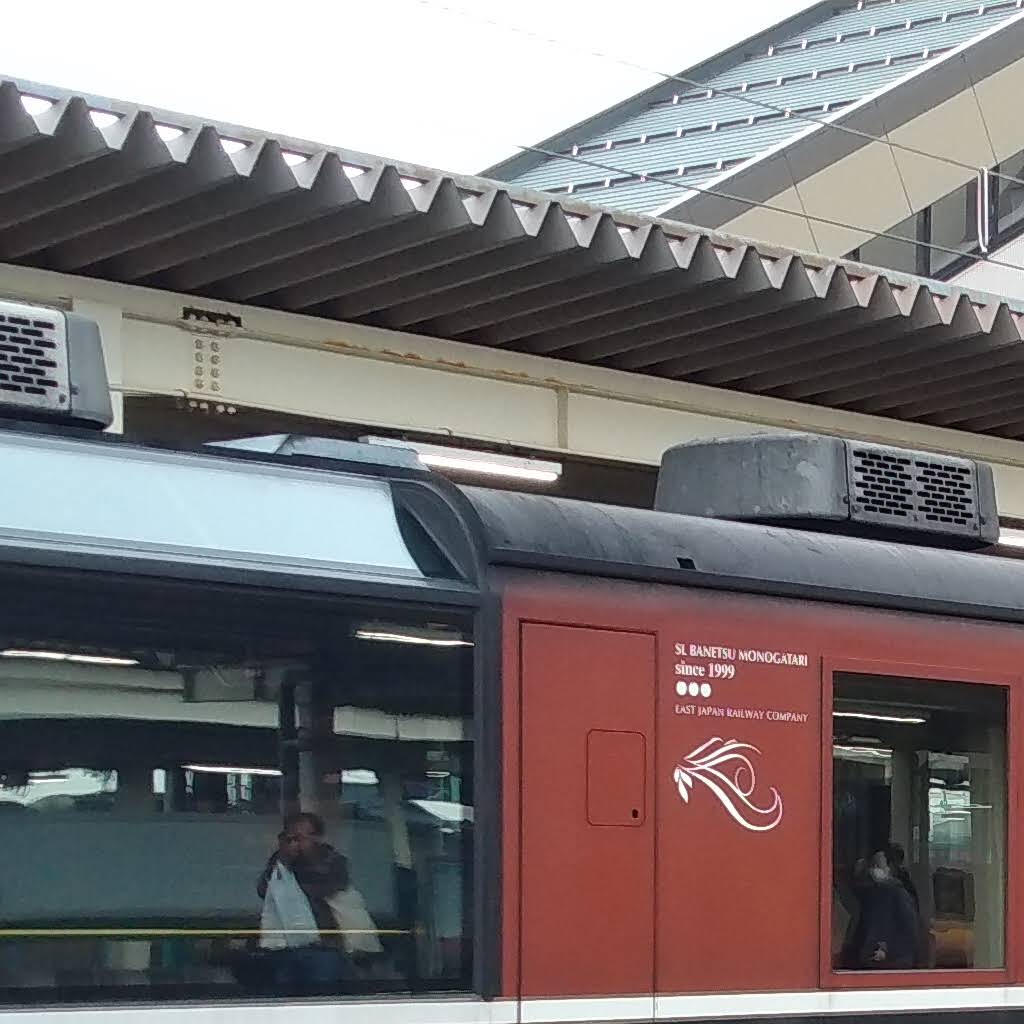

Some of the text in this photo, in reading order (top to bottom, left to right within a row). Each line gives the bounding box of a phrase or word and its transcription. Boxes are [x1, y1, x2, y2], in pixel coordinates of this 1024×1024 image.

[675, 643, 808, 666] SL BANETSU MONOGATARI
[675, 660, 735, 679] since 1999
[675, 704, 808, 723] EAST JAPAN RAILWAY COMPANY
